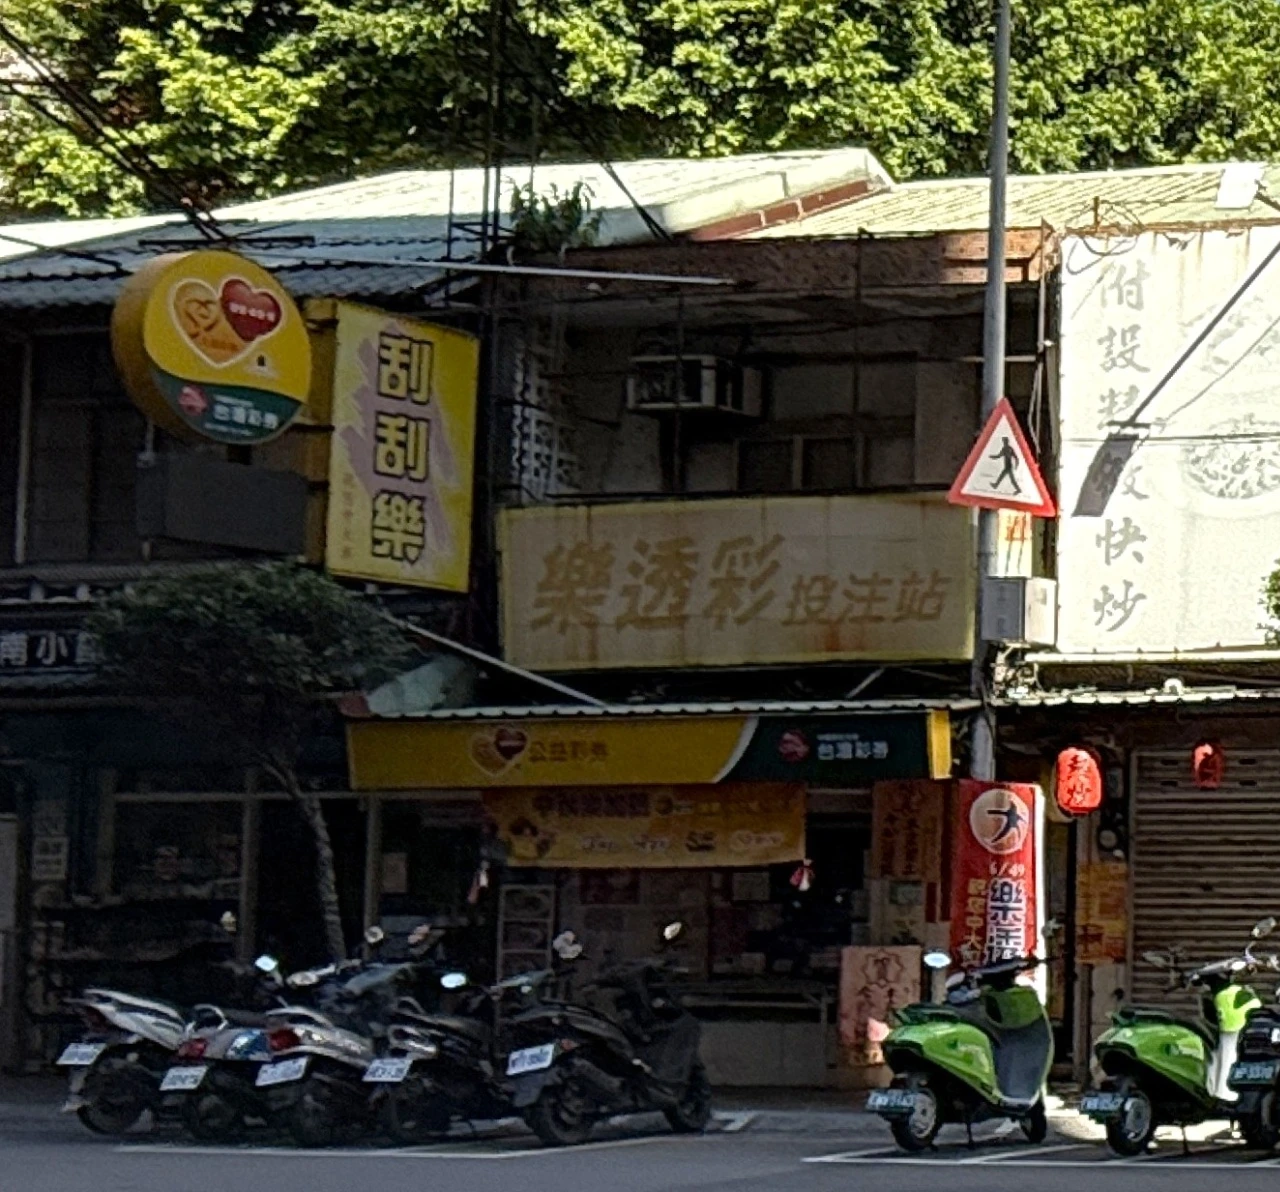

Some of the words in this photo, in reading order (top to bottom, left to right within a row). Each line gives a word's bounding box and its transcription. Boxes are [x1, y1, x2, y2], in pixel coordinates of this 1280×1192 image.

[372, 331, 435, 566] 刮刮樂
[530, 532, 952, 636] 樂透彩投注站
